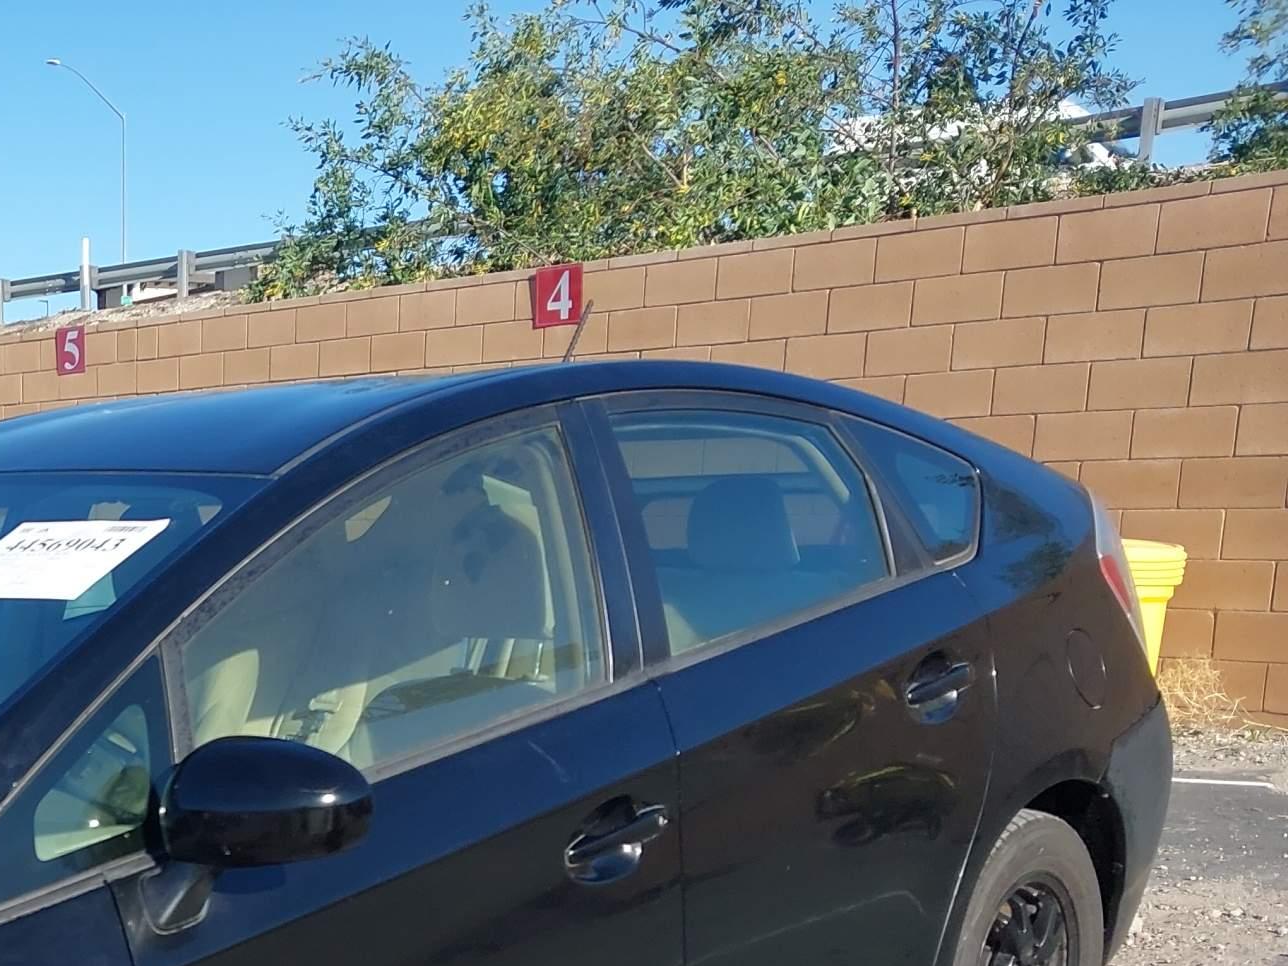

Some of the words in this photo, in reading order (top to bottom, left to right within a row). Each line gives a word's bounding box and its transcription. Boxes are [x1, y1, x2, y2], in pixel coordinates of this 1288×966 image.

[546, 269, 573, 320] 4
[63, 330, 80, 370] 5
[5, 537, 126, 552] 44569043
